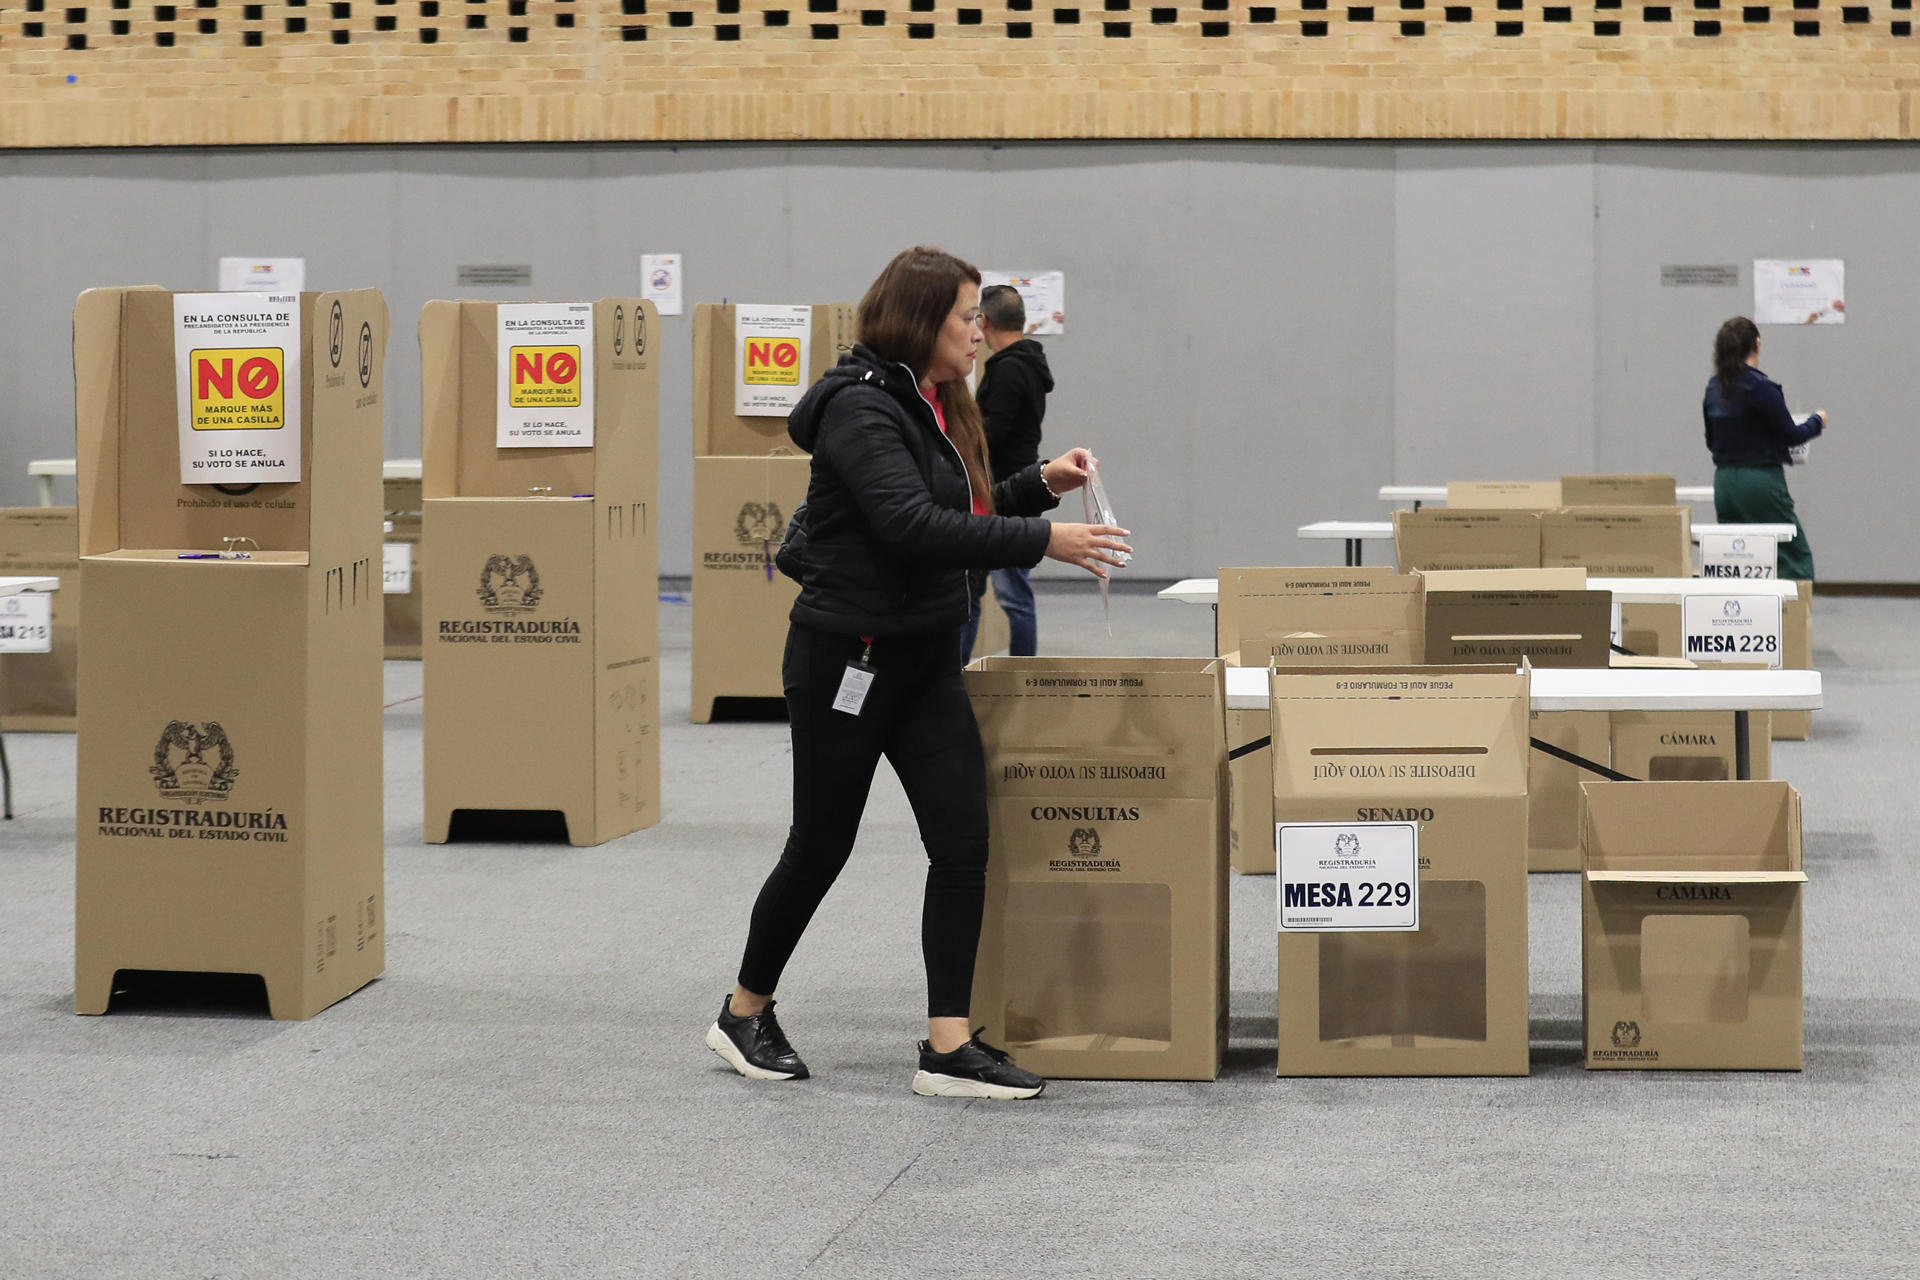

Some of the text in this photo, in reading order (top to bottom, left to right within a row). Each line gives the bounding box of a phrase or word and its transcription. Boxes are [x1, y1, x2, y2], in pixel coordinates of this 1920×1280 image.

[217, 314, 272, 322] CONSULTA
[749, 343, 797, 367] NO
[516, 352, 576, 384] NO
[198, 357, 279, 399] NO
[177, 498, 221, 508] Prohibido
[223, 500, 231, 508] el
[251, 500, 262, 508] de
[265, 500, 296, 508] celular
[1704, 565, 1772, 578] MESA 227
[439, 618, 580, 633] REGISTRADURÍA
[1297, 645, 1323, 655] VOTO
[1327, 645, 1338, 655] SU
[1341, 644, 1389, 654] DEPOSITE
[1688, 635, 1777, 652] MESA 228
[1660, 731, 1716, 745] CÁMARA
[1004, 763, 1165, 782] DEPOSITE SU VOTO AQUÍ
[1314, 763, 1476, 780] DEPOSITE SU VOTO AQUÍ
[98, 807, 287, 830] REGISTRADURÍA
[1031, 806, 1140, 820] CONSULTAS
[1357, 808, 1434, 822] SENADO
[98, 826, 288, 842] NACIONAL DEL ESTADO CIVIL
[1049, 858, 1120, 867] REGISTRADURÍA
[1285, 882, 1411, 907] MESA 229
